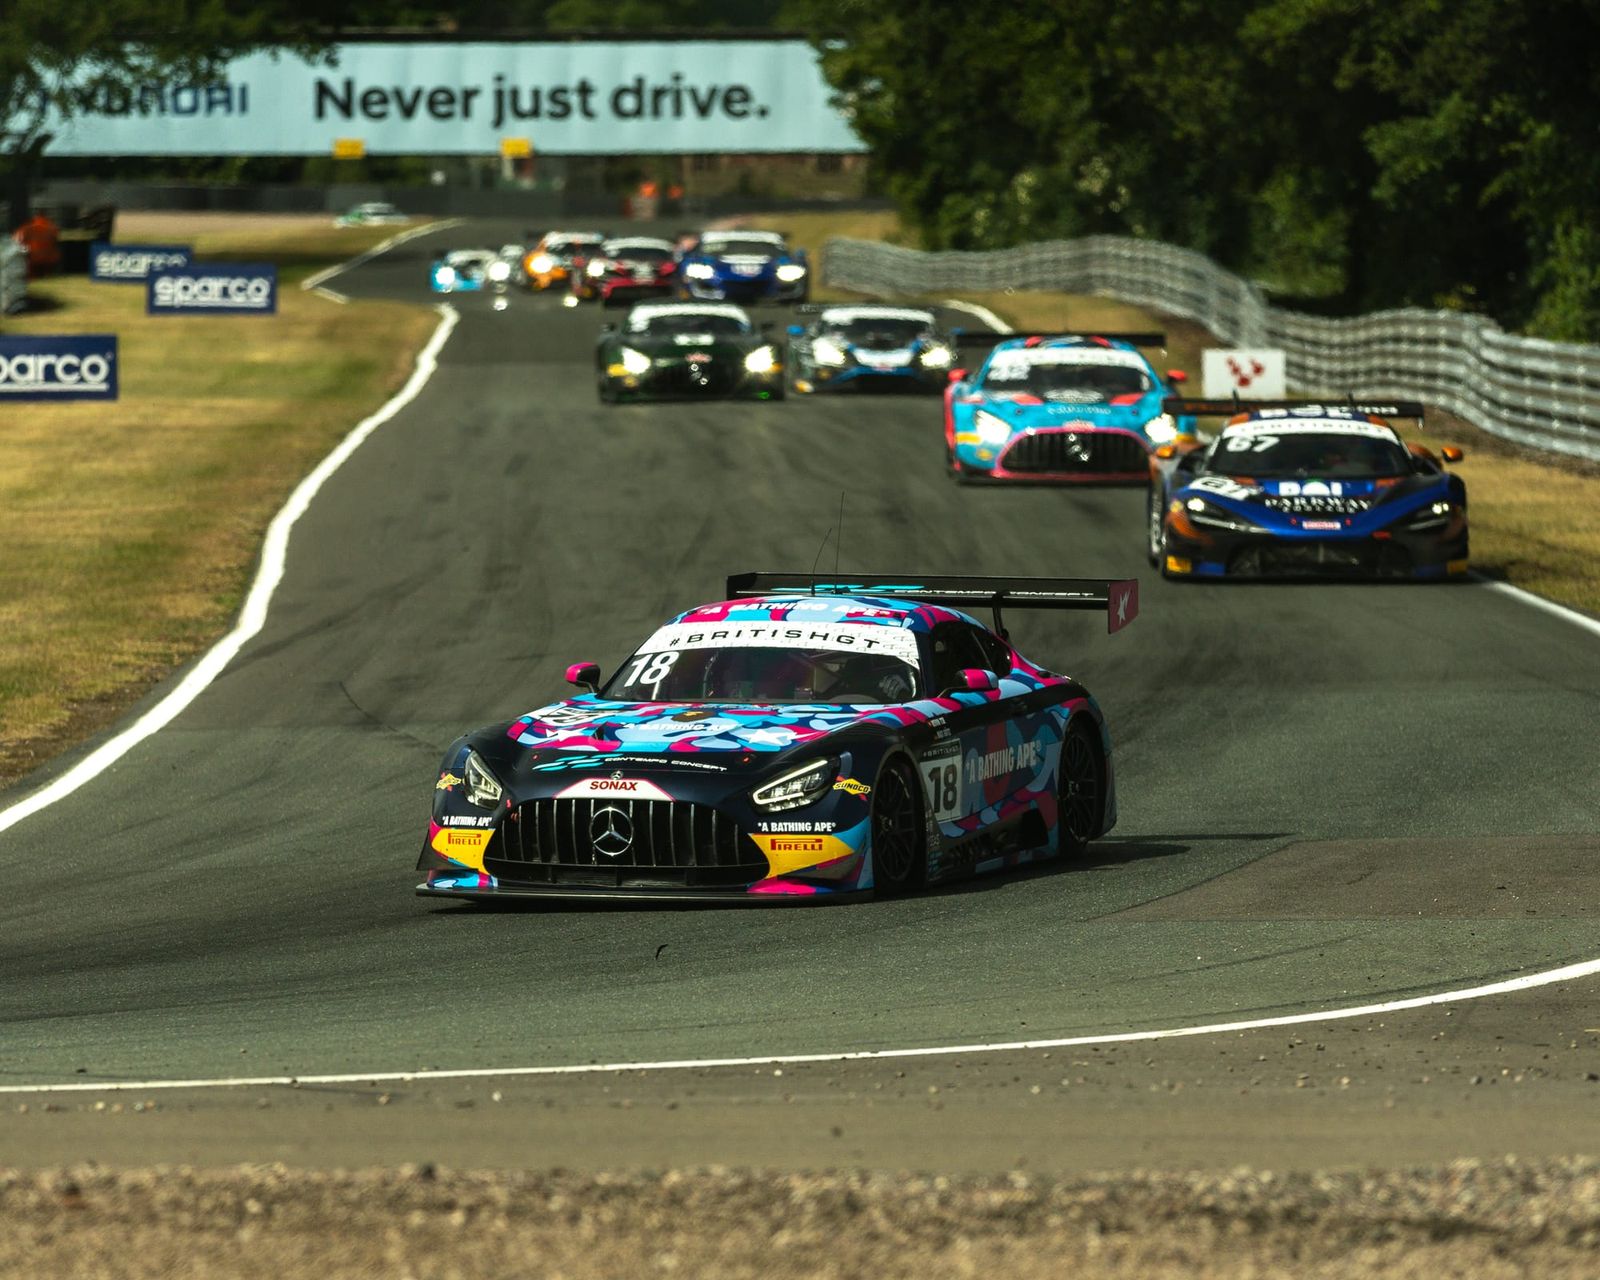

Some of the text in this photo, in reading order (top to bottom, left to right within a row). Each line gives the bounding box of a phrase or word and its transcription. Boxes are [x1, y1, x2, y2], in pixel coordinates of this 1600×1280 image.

[314, 73, 770, 128] Never just drive.
[155, 276, 270, 306] sparco
[1227, 436, 1280, 452] 67
[669, 629, 880, 649] #BRITISHGT
[624, 651, 680, 687] 18
[671, 760, 728, 772] CONCEPT
[978, 747, 1014, 781] BATHING
[590, 781, 638, 792] SONAX
[835, 782, 870, 793] SUNOCO
[928, 764, 958, 814] 18
[449, 816, 477, 826] BATHING
[771, 822, 812, 832] BATHING
[448, 833, 481, 845] PIRELLI
[770, 839, 823, 851] PIRELLI
